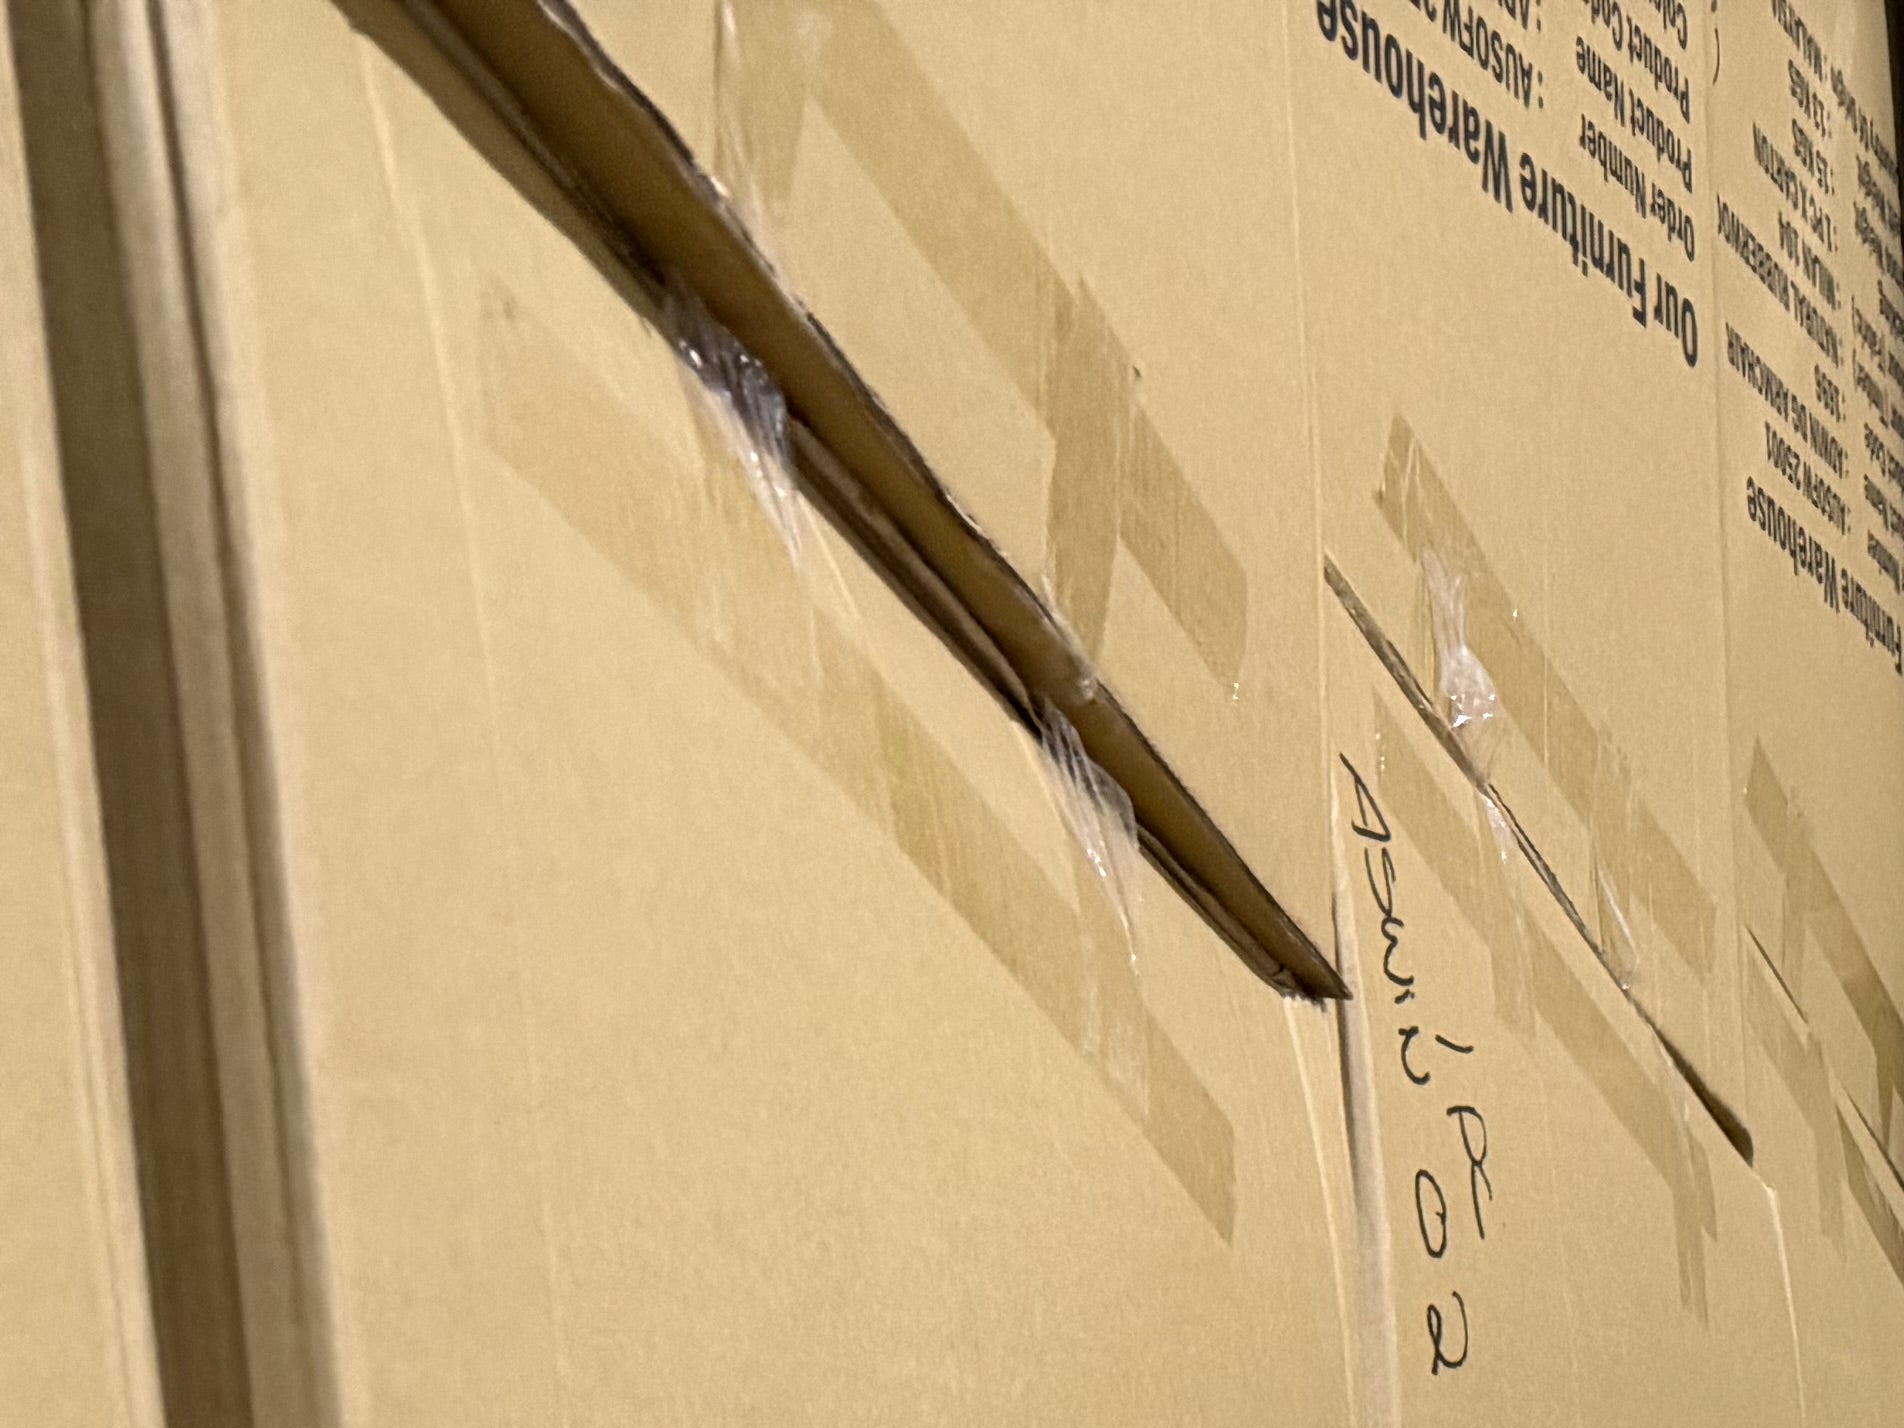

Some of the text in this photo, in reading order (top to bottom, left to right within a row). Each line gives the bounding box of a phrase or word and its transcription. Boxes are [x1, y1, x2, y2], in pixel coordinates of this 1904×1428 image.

[1317, 0, 1514, 213] Warehouse
[1442, 0, 1533, 108] AUSOFW
[1576, 35, 1626, 128] Name
[1628, 14, 1691, 123] Product
[1578, 113, 1648, 219] Number
[1630, 88, 1693, 194] Product
[1519, 152, 1648, 328] Furniture
[1650, 182, 1695, 262] Order
[1655, 272, 1698, 366] Our
[1746, 476, 1839, 615] Warehouse
[1839, 567, 1903, 677] Furniture
